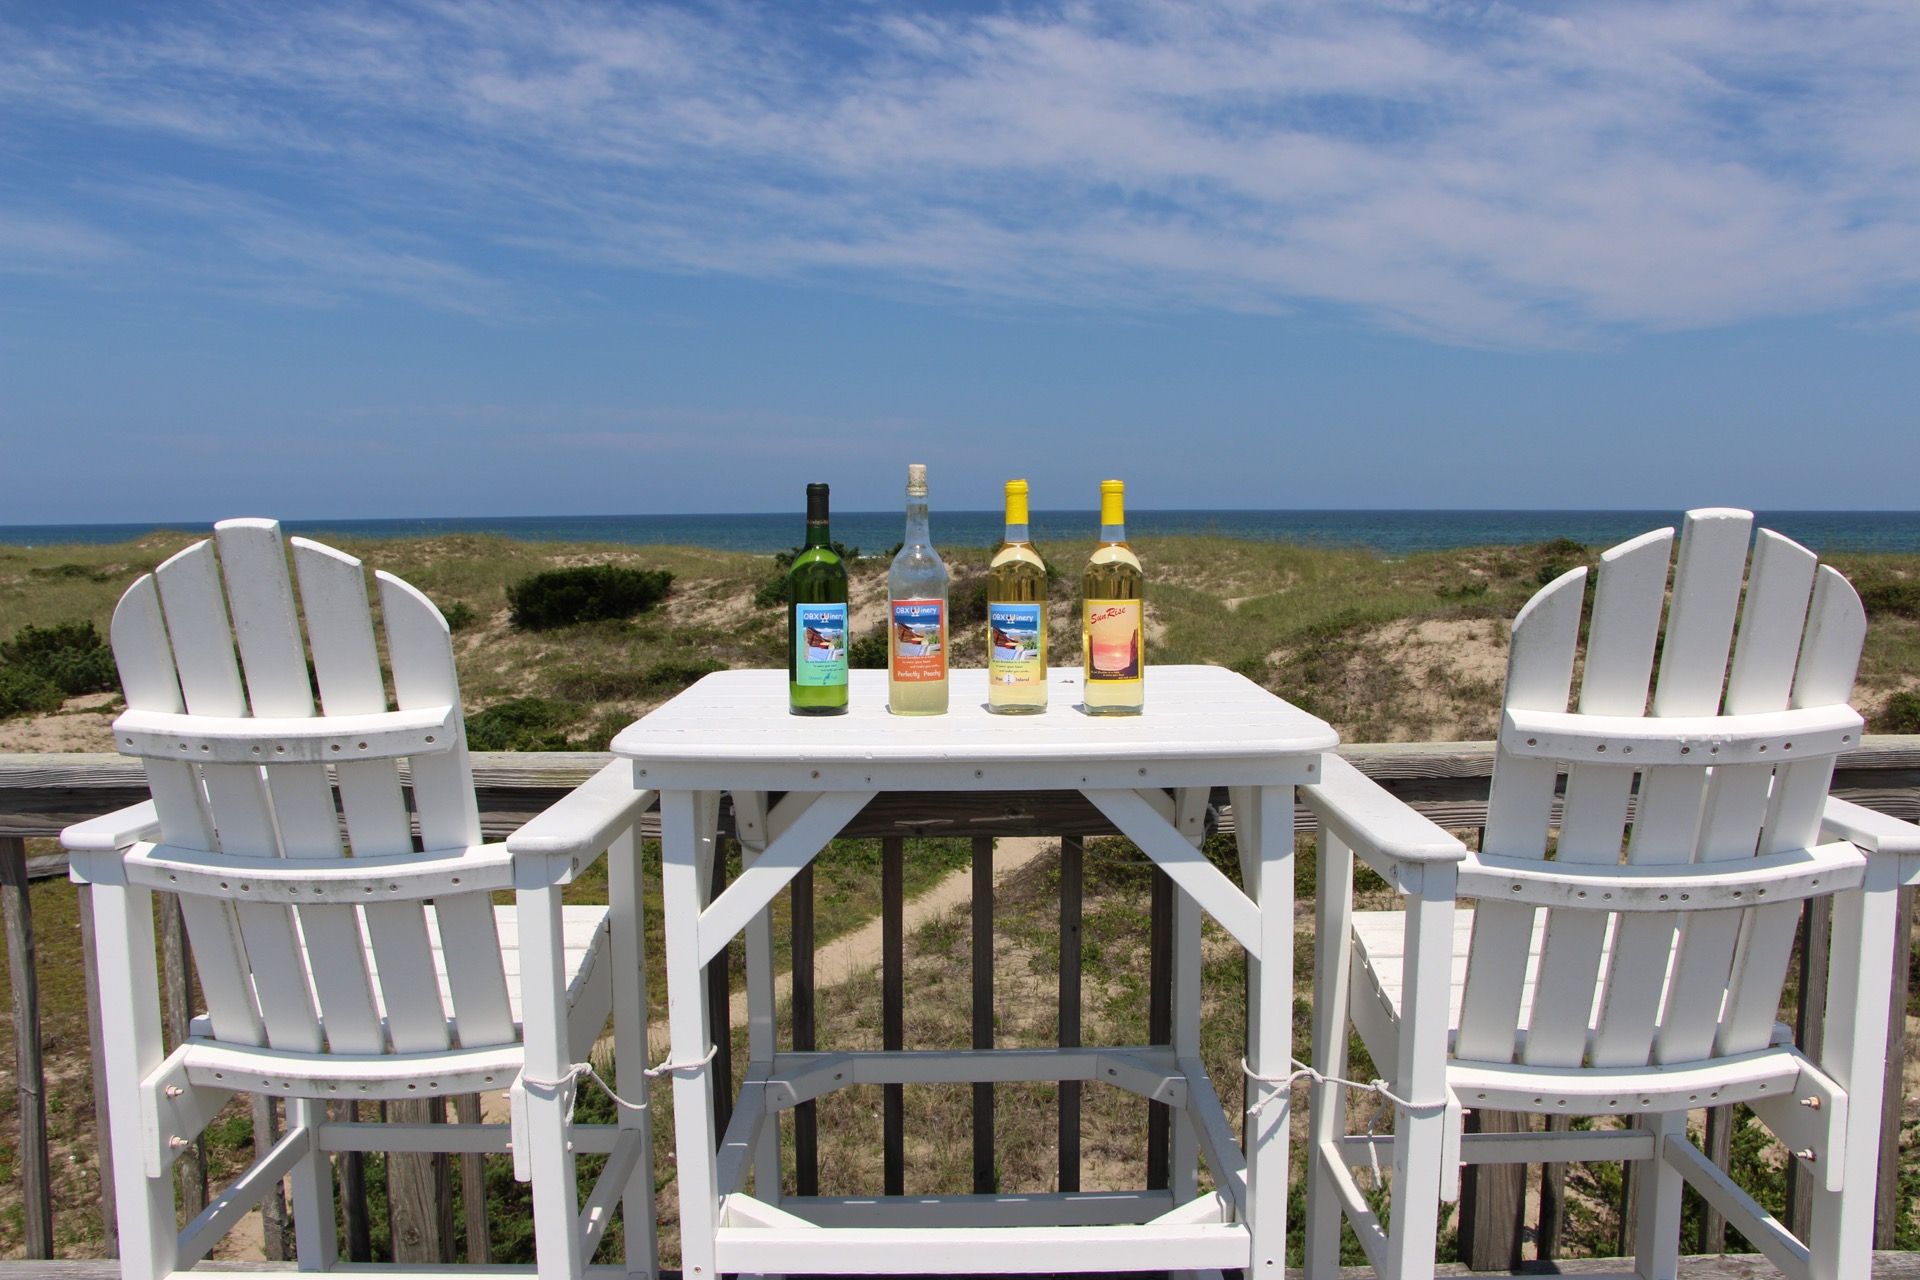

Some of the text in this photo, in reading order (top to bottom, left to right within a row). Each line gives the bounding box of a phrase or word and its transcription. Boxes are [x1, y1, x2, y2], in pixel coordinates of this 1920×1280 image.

[803, 612, 819, 620] OBX
[895, 605, 937, 617] OBX Winery
[992, 613, 1034, 624] OBX Winery
[897, 670, 941, 679] Perfectly Peachy
